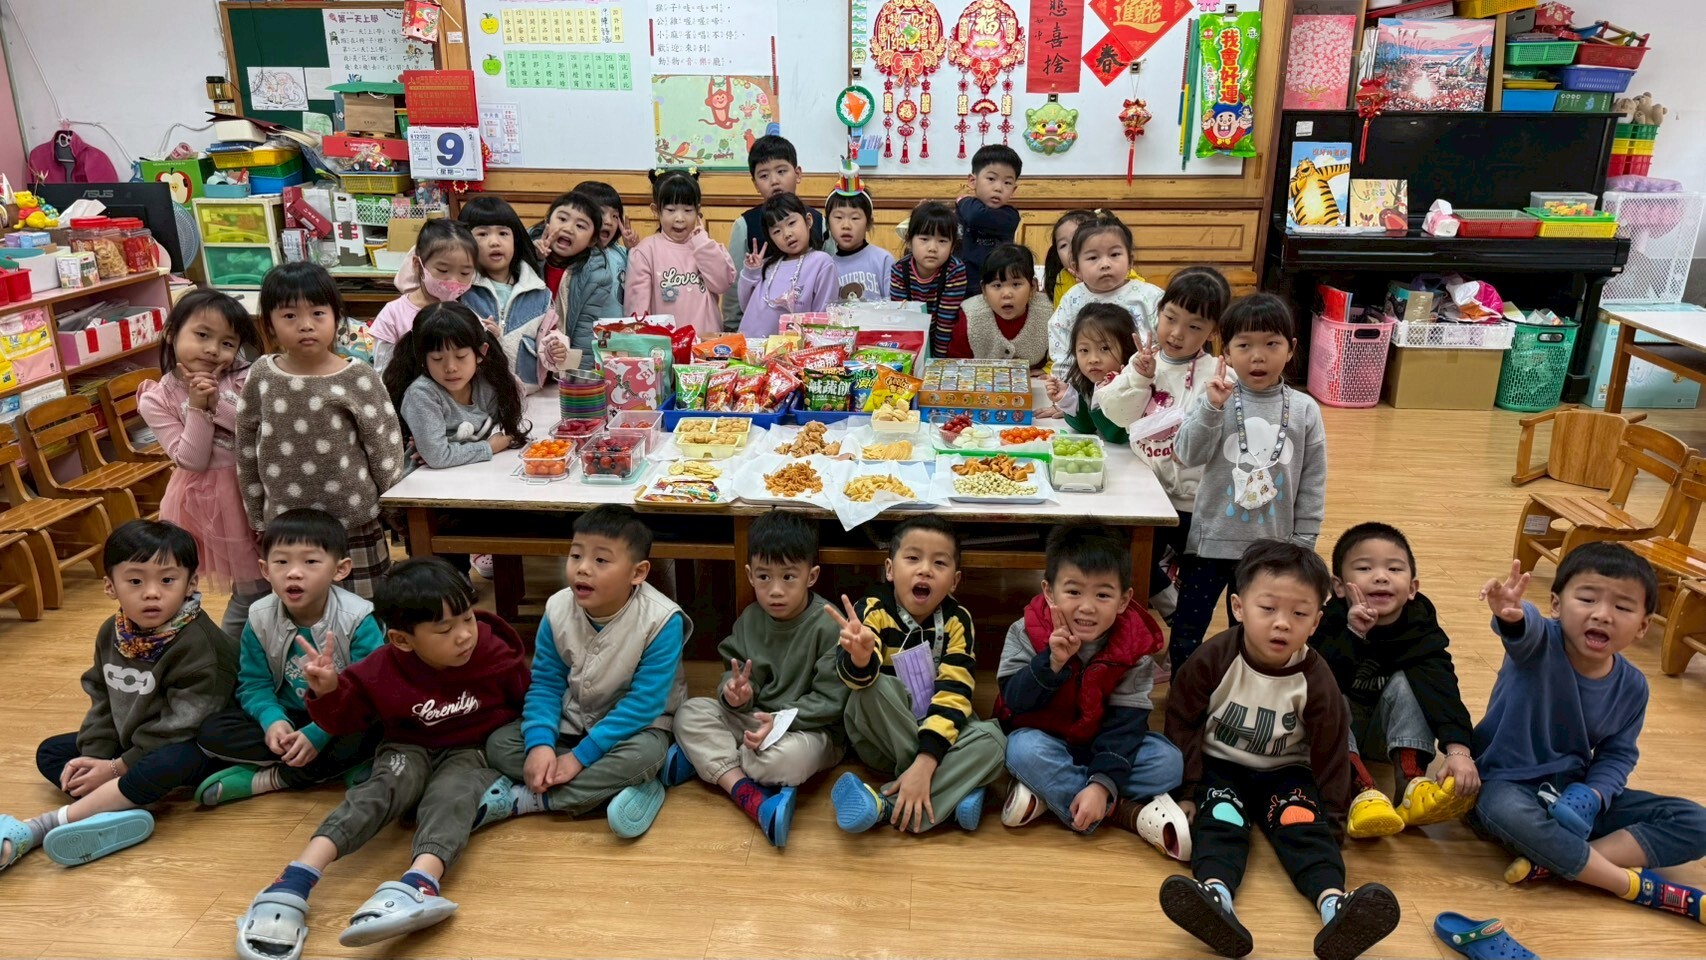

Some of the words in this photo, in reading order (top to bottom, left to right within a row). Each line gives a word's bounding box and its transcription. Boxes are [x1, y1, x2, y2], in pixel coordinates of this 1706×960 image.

[338, 14, 379, 23] 第一天上學
[975, 8, 1000, 34] 福
[1095, 43, 1126, 74] 春
[1219, 28, 1241, 104] 我會好運
[437, 132, 465, 167] 9
[82, 189, 114, 198] ASUS
[412, 690, 479, 725] Serenity
